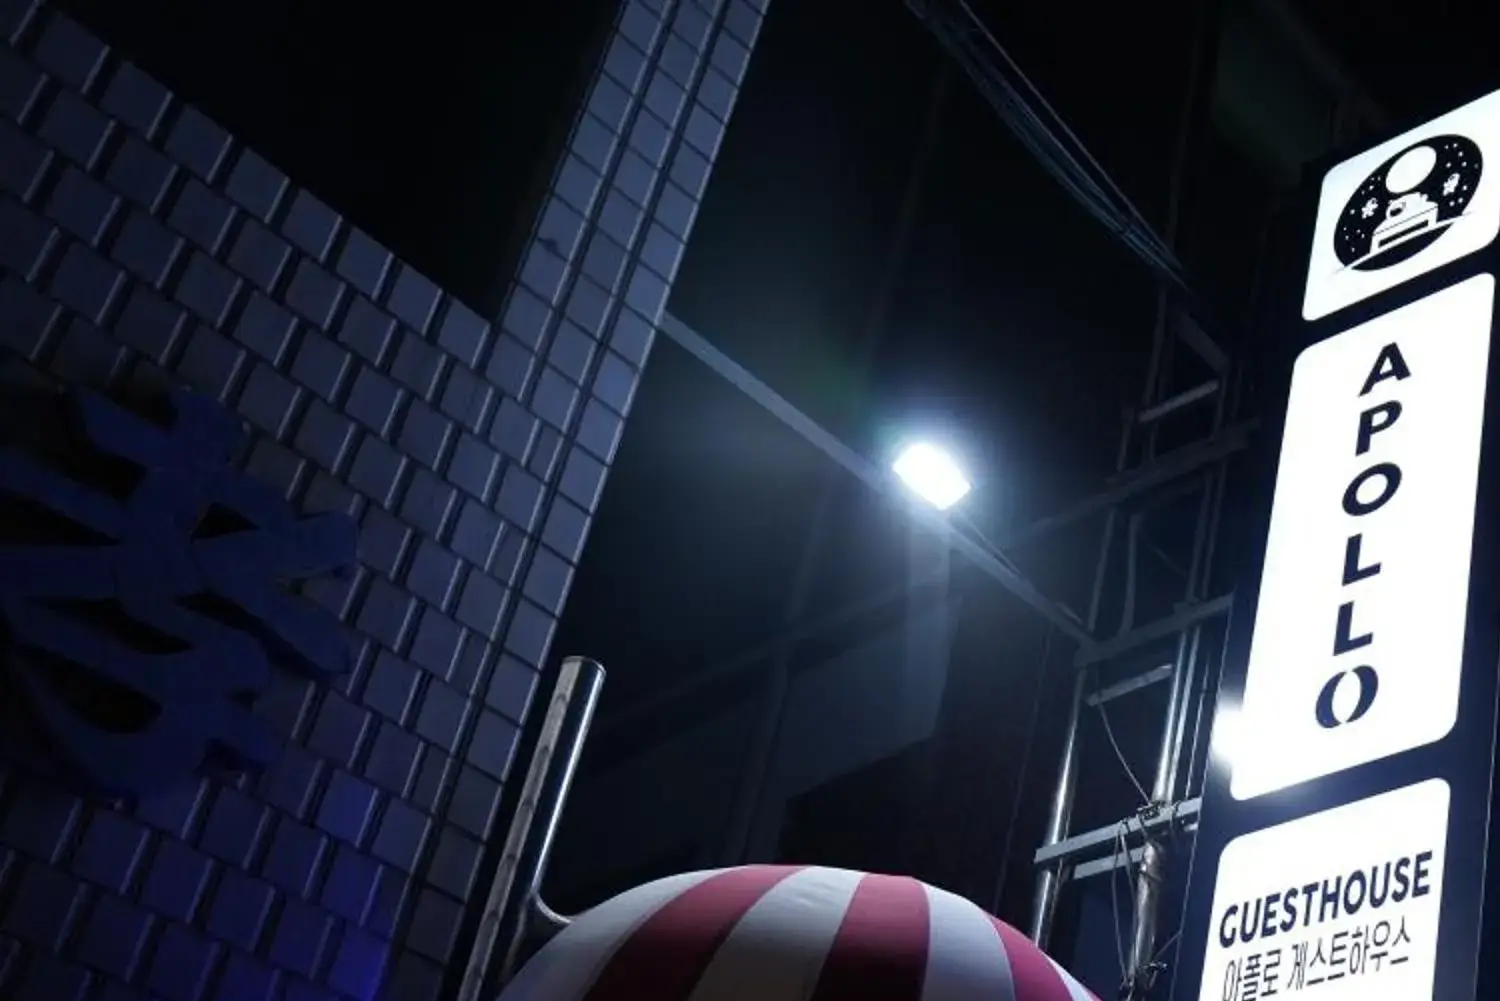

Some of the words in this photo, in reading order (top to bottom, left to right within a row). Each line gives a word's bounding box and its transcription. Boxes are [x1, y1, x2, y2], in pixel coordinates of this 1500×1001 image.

[1315, 341, 1411, 730] APOLLO
[1218, 850, 1433, 949] GUESTHOUSE
[1287, 915, 1411, 990] 게스트하우스
